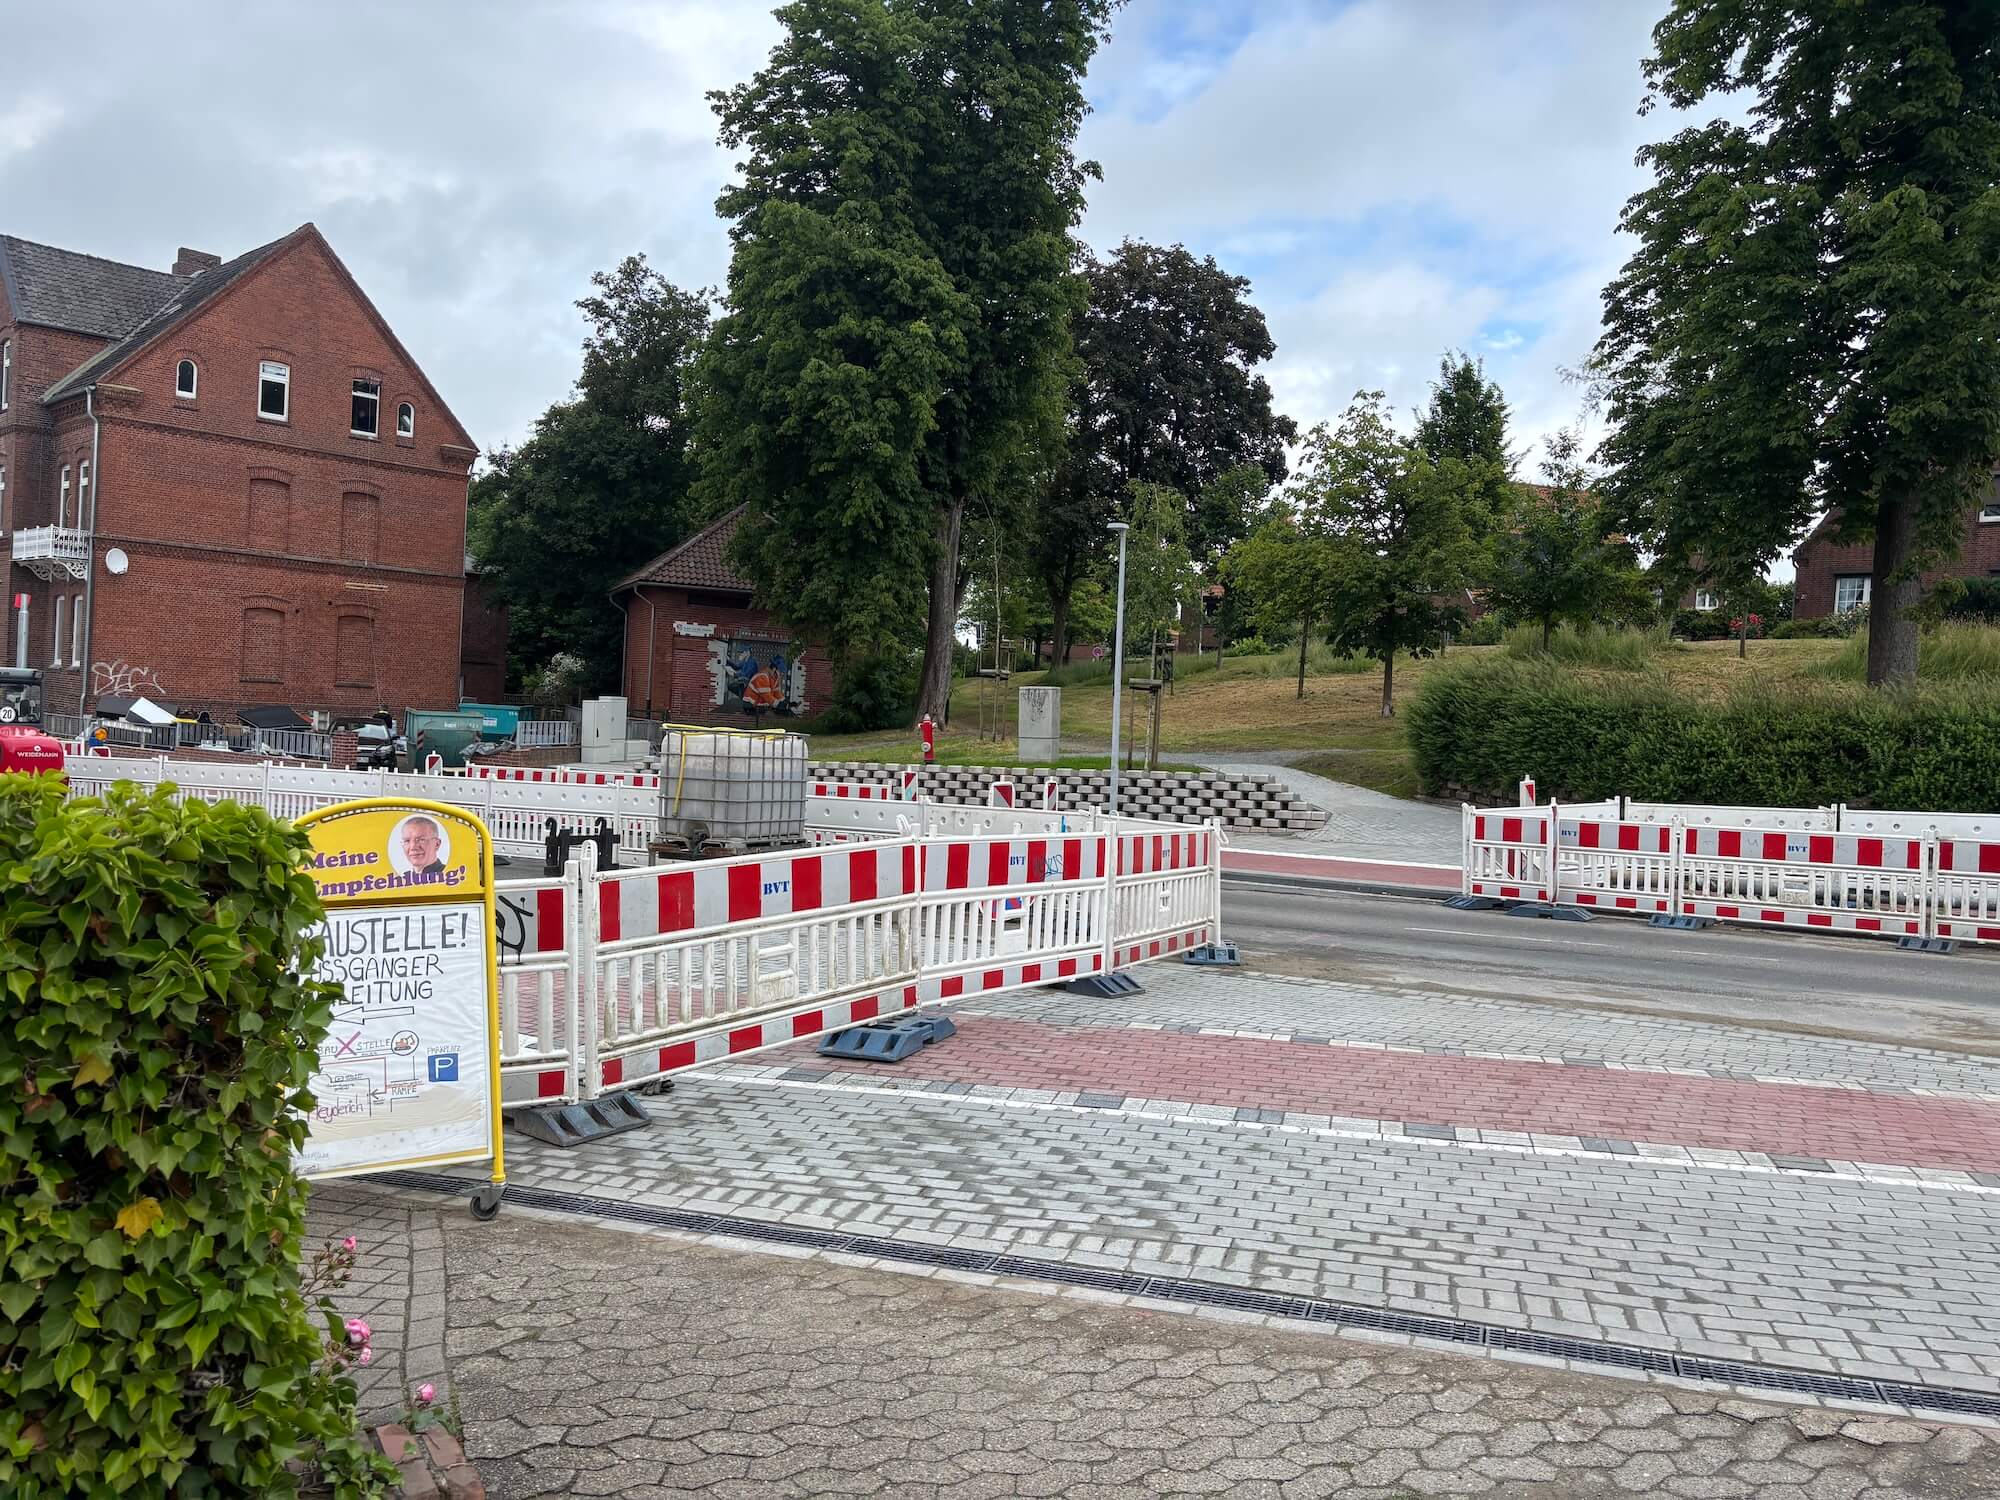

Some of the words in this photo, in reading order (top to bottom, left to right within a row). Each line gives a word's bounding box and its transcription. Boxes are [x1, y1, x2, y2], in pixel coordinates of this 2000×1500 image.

[2, 709, 13, 720] 20
[1787, 844, 1808, 853] BVT
[1010, 855, 1026, 866] BVT
[313, 865, 466, 897] mpfehlung!
[763, 880, 790, 895] BVT
[304, 912, 468, 958] AUSTELLE!
[356, 1038, 391, 1051] STELLE
[434, 1056, 454, 1081] P
